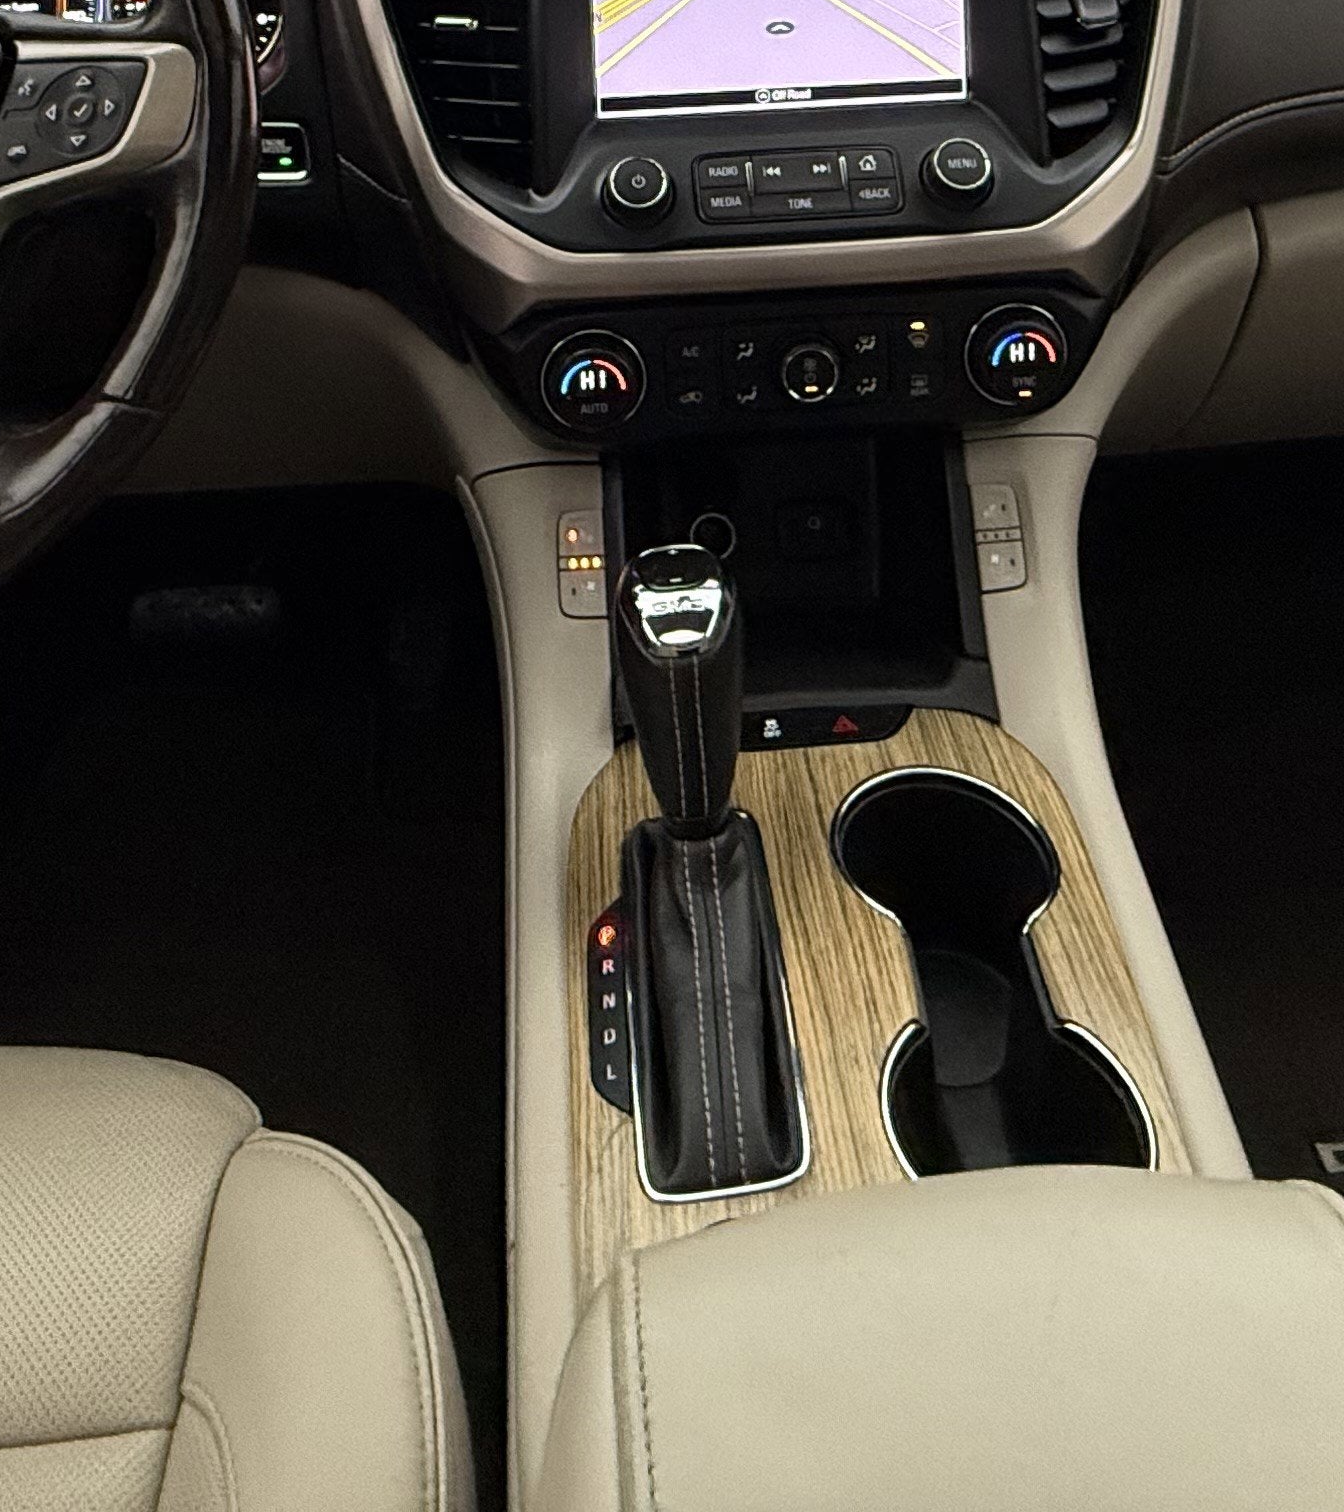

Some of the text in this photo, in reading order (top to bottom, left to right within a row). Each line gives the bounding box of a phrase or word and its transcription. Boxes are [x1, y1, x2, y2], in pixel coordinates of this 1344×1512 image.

[947, 157, 978, 170] MENU
[708, 166, 739, 178] RADIO
[710, 196, 742, 209] MEDIA
[788, 197, 814, 210] TONE
[1010, 342, 1036, 363] HI
[580, 370, 607, 391] HI
[580, 403, 609, 415] AUTO
[598, 925, 617, 947] P
[602, 959, 615, 975] R
[602, 993, 616, 1010] N
[603, 1028, 616, 1045] D
[606, 1064, 617, 1081] L
